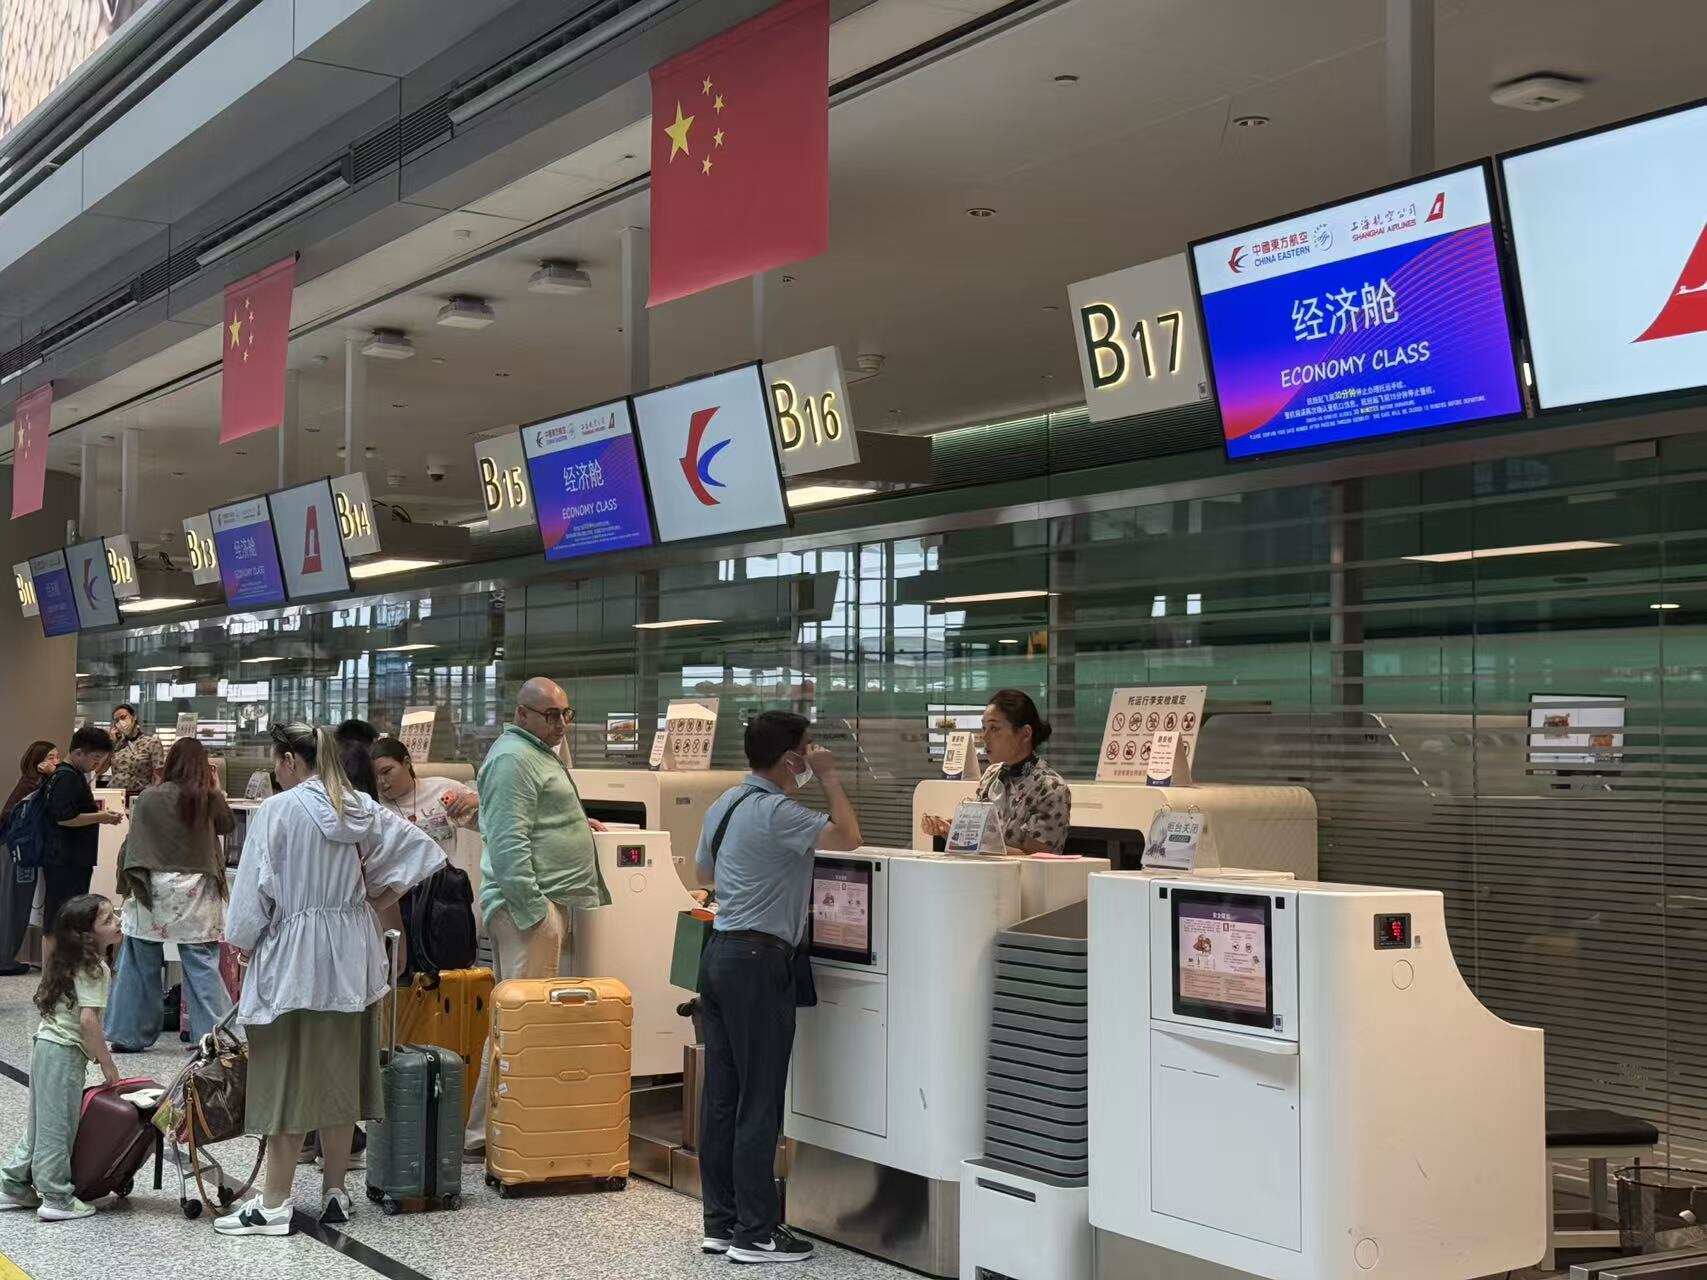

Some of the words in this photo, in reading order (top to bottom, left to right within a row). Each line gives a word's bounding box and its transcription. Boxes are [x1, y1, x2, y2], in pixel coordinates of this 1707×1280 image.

[1251, 231, 1309, 256] 中國東方航空
[1352, 227, 1385, 242] SHANGHAI
[1386, 218, 1417, 234] AIRLINES
[1254, 254, 1276, 268] CHINA
[1277, 245, 1311, 263] EASTERN
[1291, 278, 1400, 342] 经济舱
[1081, 303, 1183, 389] B17
[1280, 352, 1366, 389] ECONOMY
[1372, 341, 1431, 371] CLASS
[771, 381, 842, 450] B16
[480, 457, 528, 511] B15
[563, 459, 604, 492] 经济舱
[336, 492, 371, 540] B14
[562, 502, 595, 520] ECONOMY
[596, 498, 618, 514] CLASS
[107, 547, 134, 585] B12
[186, 529, 217, 571] B13
